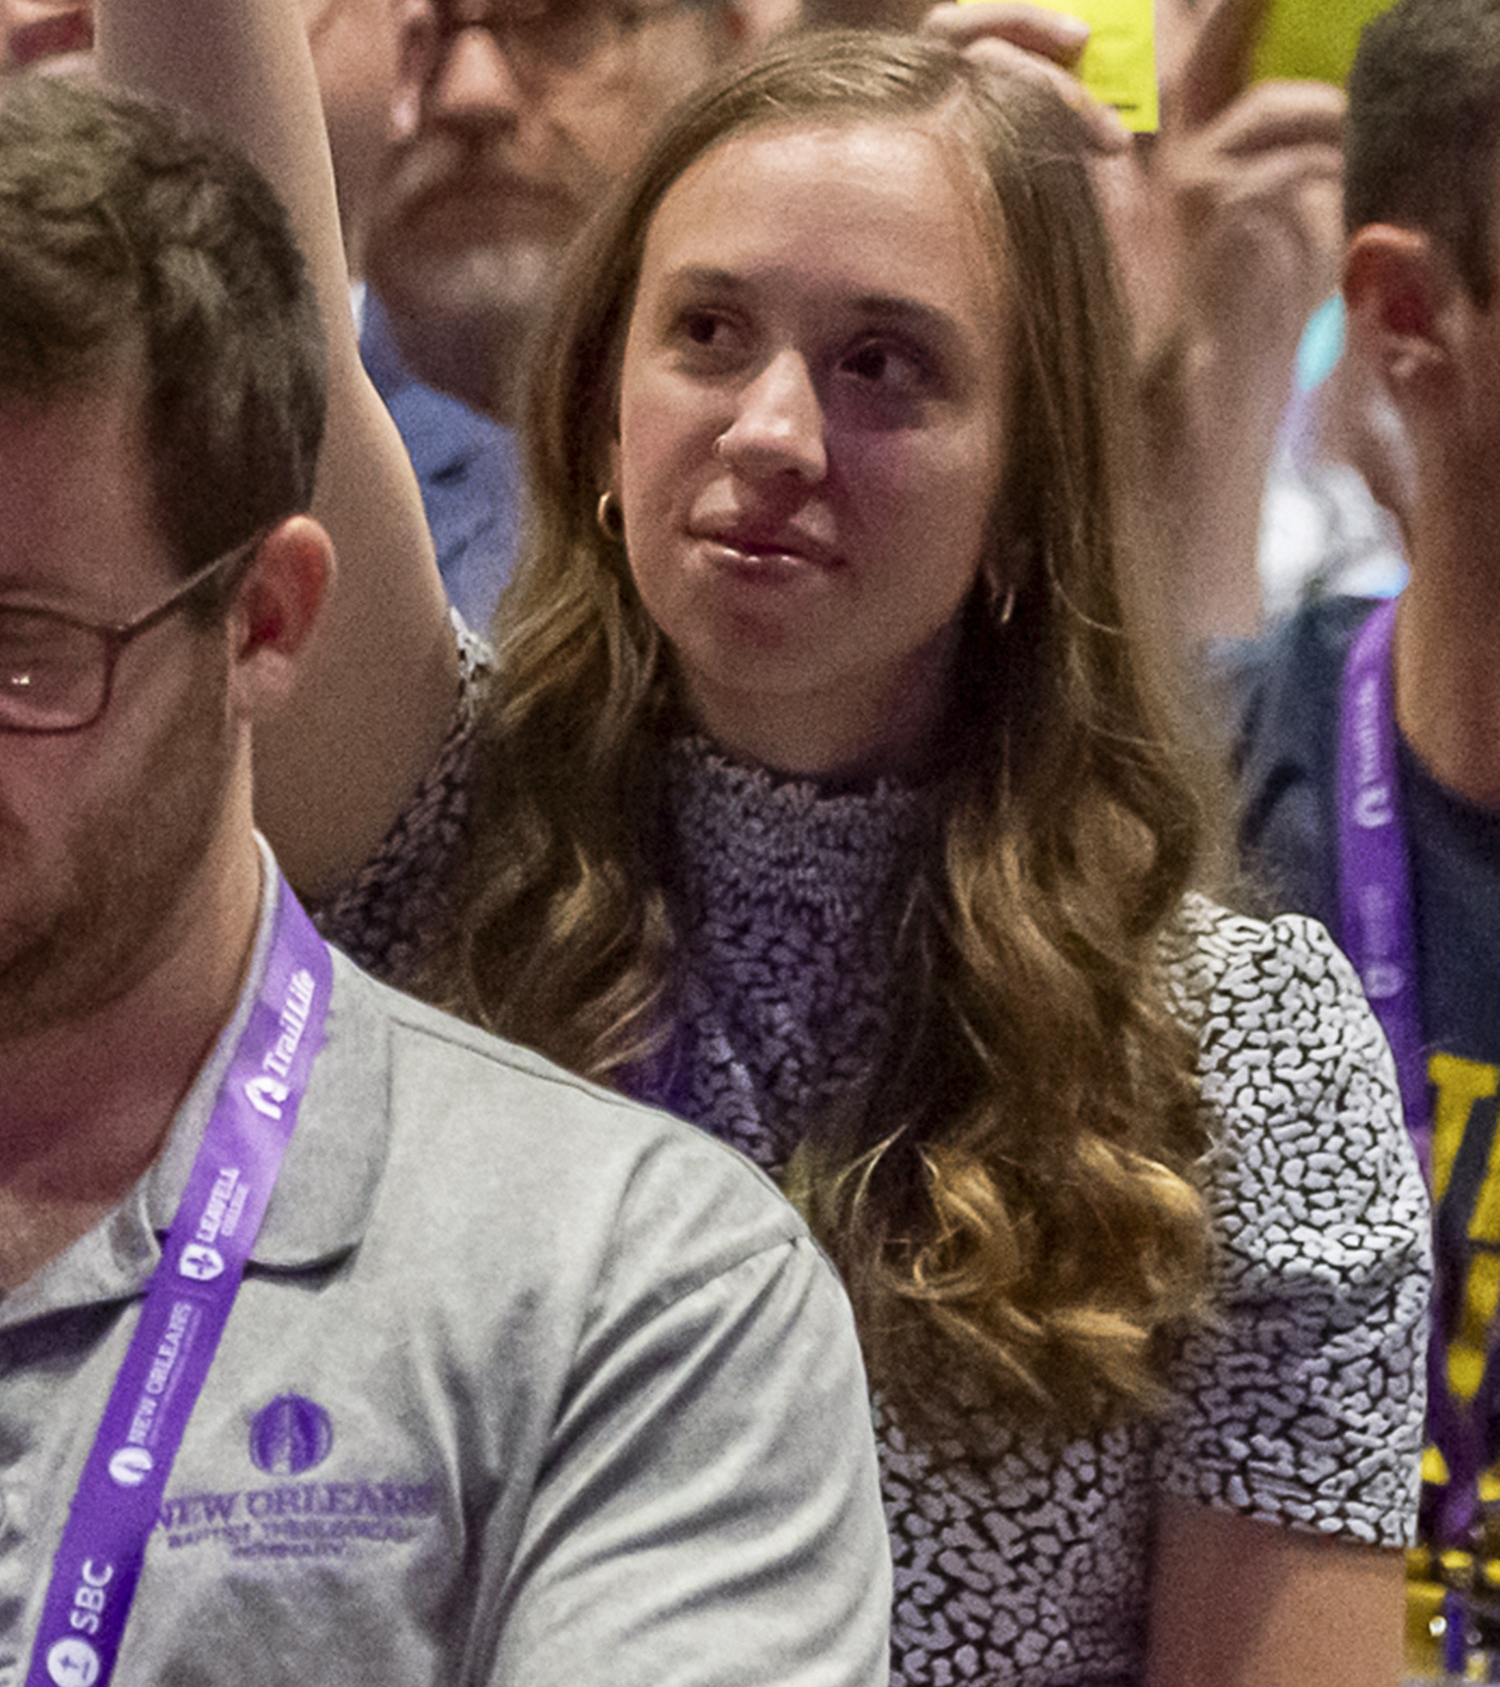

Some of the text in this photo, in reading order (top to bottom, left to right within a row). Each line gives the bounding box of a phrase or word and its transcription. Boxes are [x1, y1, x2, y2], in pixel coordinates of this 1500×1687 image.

[127, 1396, 158, 1446] NEW
[145, 1301, 193, 1395] ORLEANS
[70, 1559, 114, 1634] SBC
